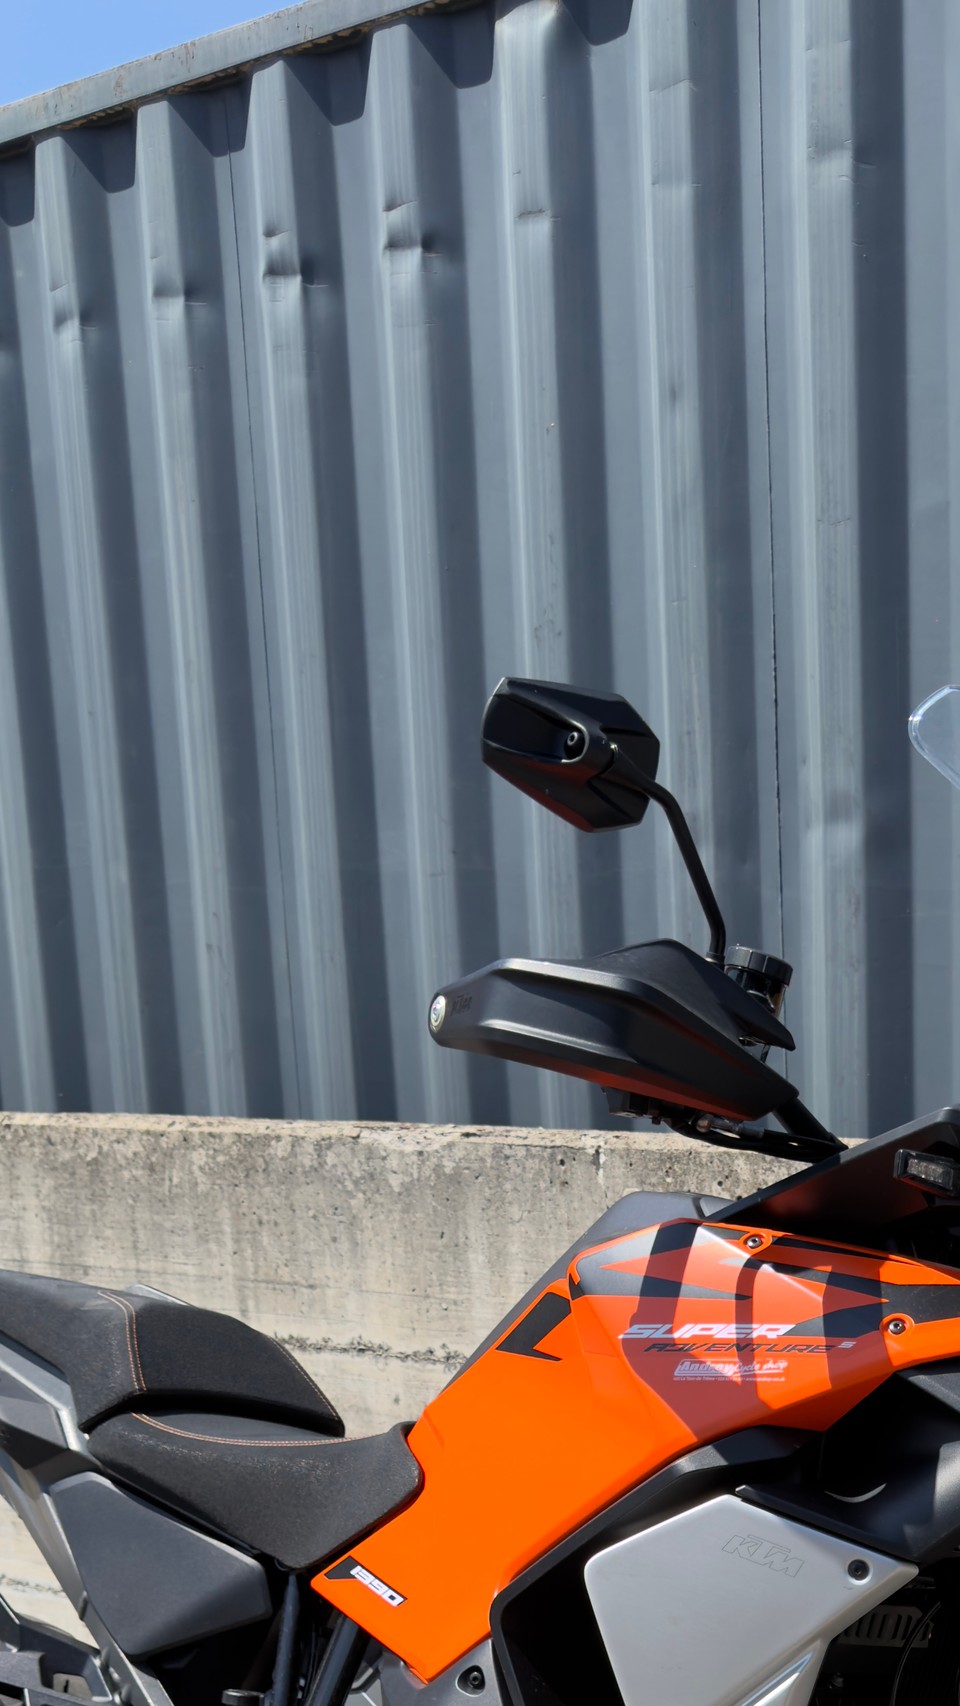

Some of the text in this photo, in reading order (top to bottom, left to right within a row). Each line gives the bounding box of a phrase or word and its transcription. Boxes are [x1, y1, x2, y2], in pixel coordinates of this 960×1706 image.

[618, 1323, 796, 1339] SUPER
[644, 1343, 835, 1354] ADVENTURE
[721, 1534, 805, 1578] KTM
[349, 1564, 405, 1607] 1390
